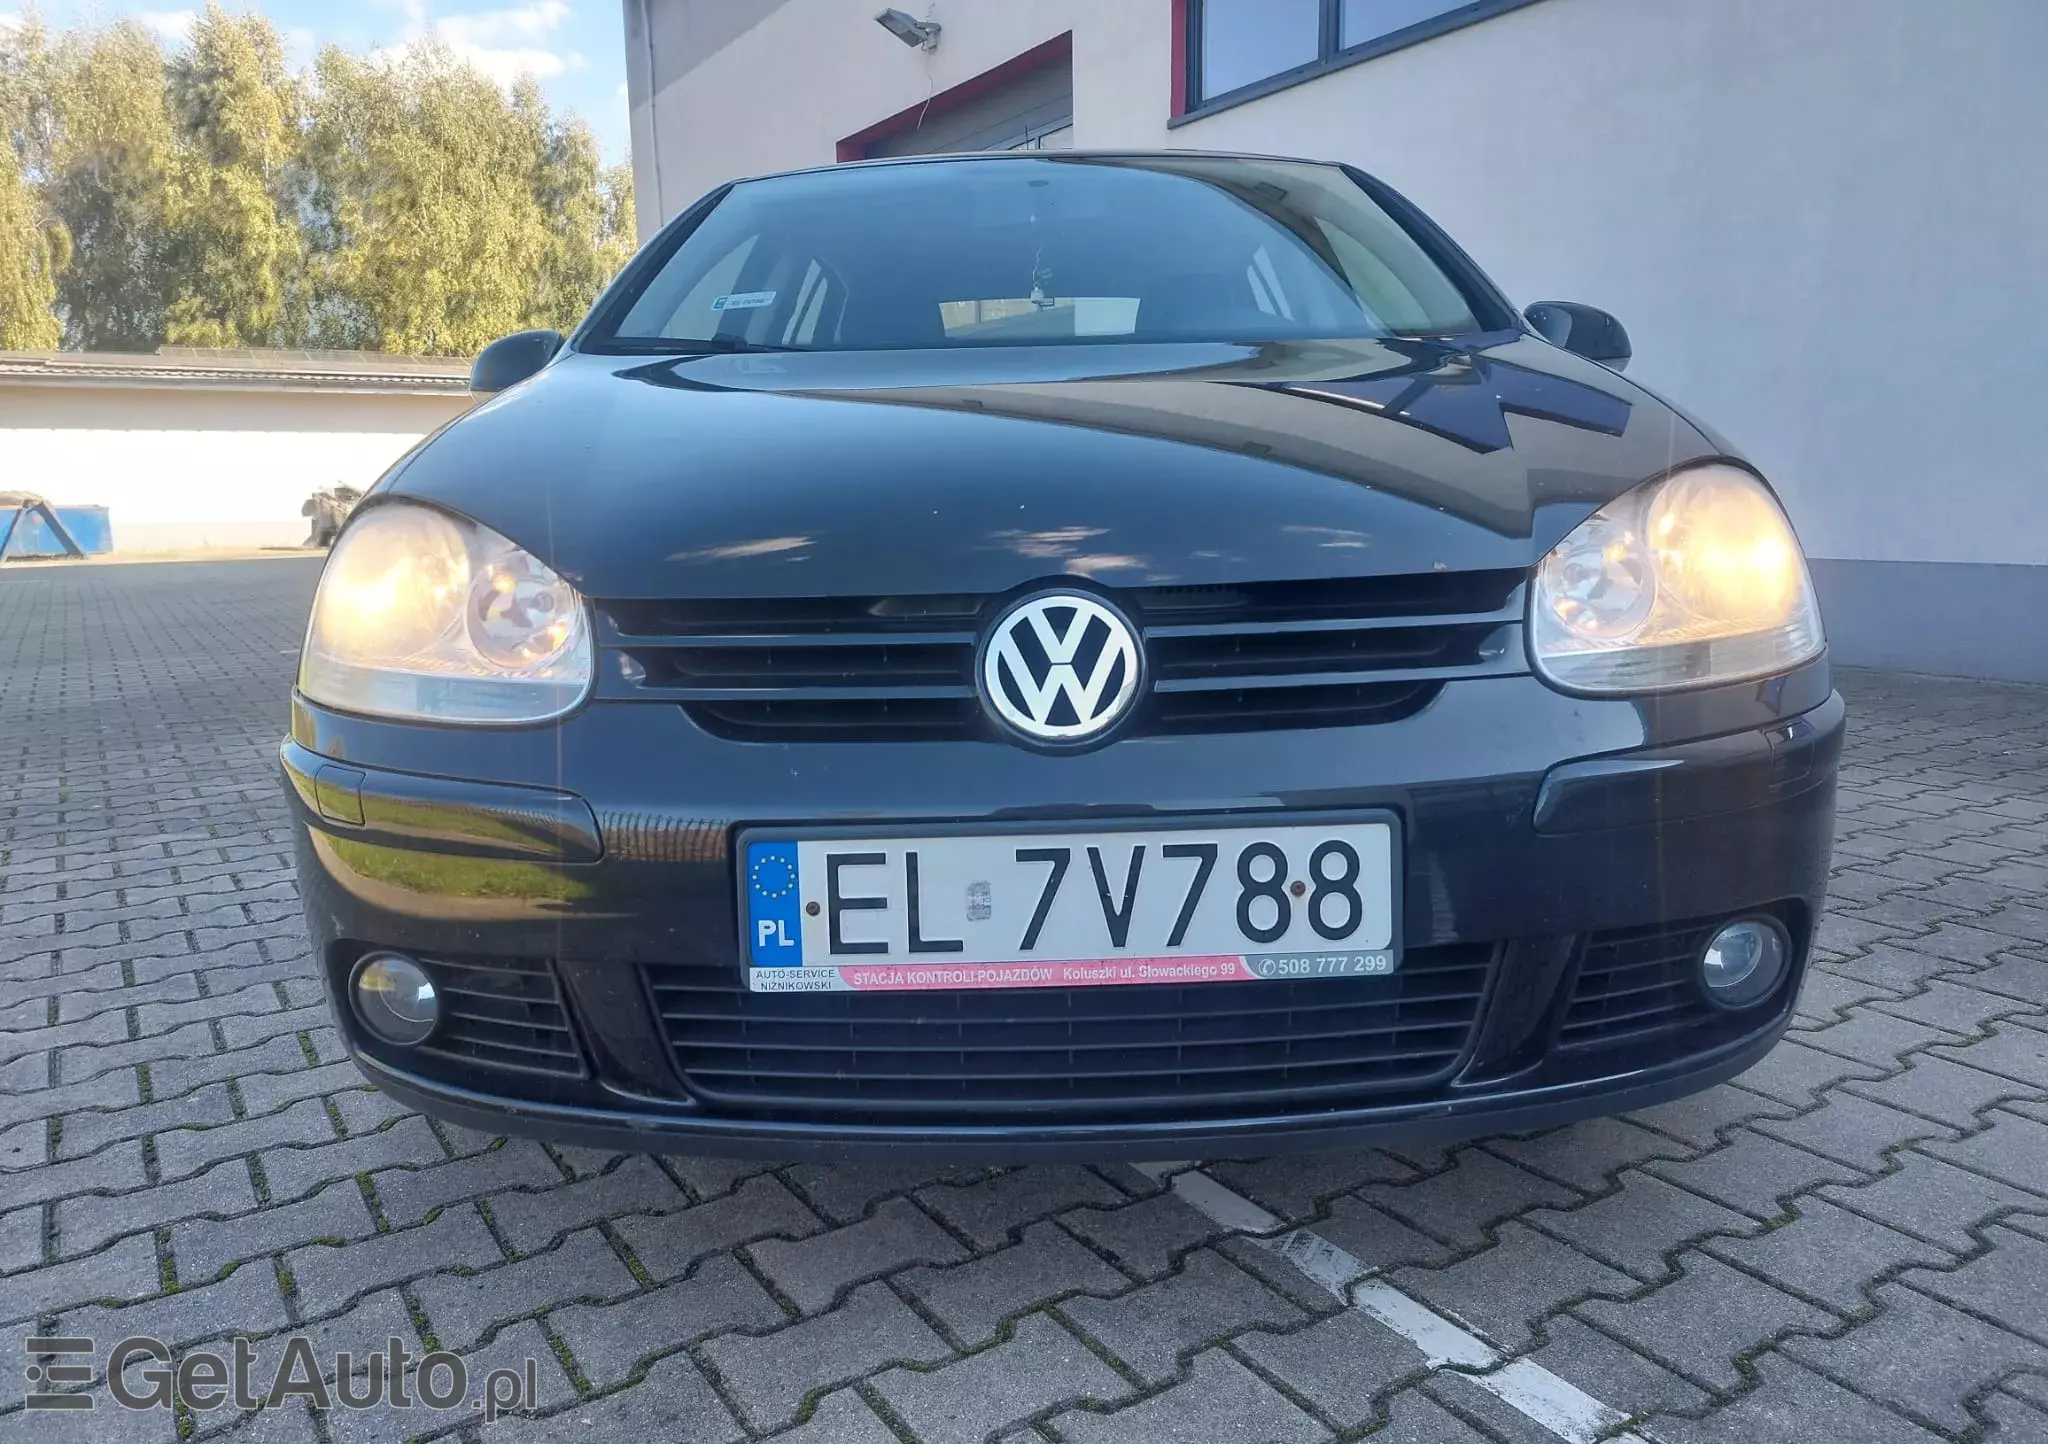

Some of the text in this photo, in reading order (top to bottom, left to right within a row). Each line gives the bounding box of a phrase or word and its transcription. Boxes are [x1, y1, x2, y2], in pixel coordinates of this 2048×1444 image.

[985, 596, 1137, 737] VW
[826, 839, 1363, 954] EL 7V788
[758, 919, 795, 947] PL
[854, 972, 903, 985] STACJA
[907, 969, 974, 983] KONTROLI
[978, 965, 1053, 983] POJAZDÓW
[1063, 967, 1116, 980] Koluszki
[1120, 966, 1135, 978] ul.
[1221, 962, 1235, 975] 99
[1278, 955, 1387, 974] 508 777 299
